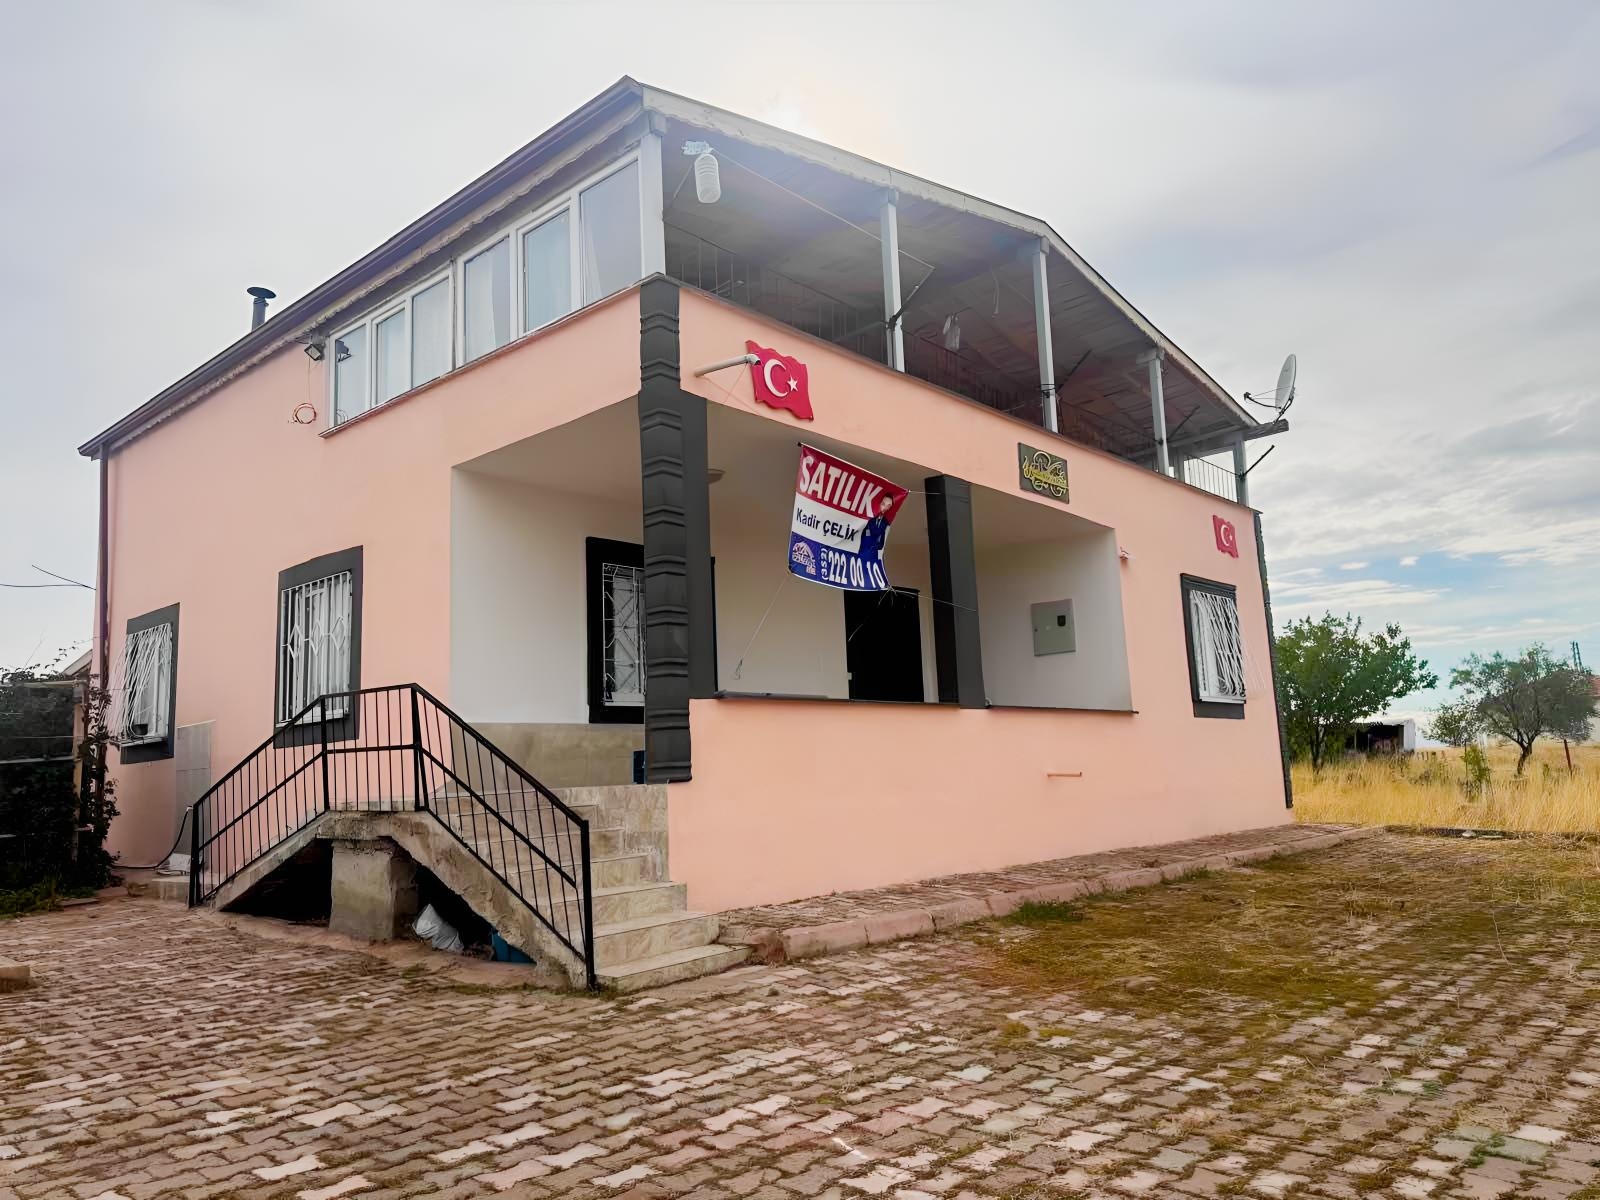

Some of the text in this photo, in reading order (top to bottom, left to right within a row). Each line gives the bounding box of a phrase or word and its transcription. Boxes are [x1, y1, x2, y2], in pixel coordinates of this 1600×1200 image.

[800, 455, 883, 518] SATILIK
[797, 507, 859, 542] Kadir ÇELİK
[828, 550, 848, 585] 222
[850, 556, 865, 588] 00
[866, 561, 886, 589] 10
